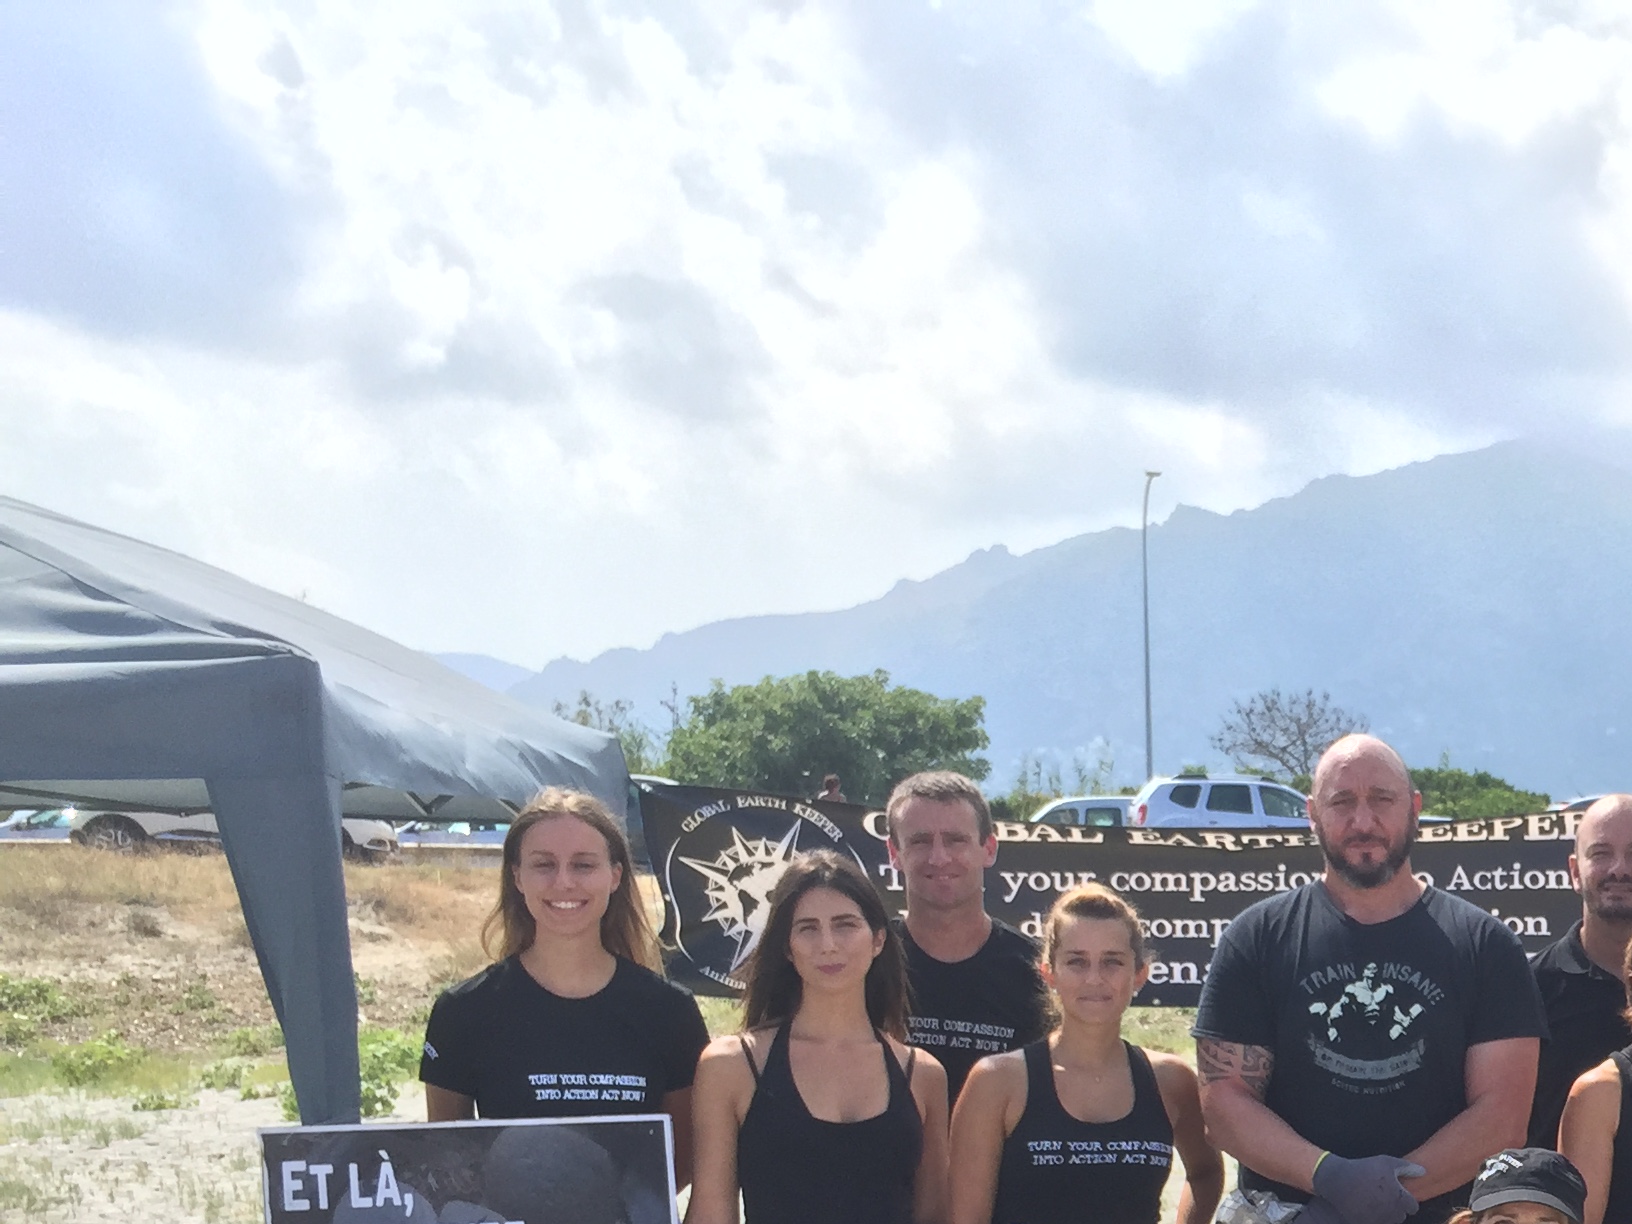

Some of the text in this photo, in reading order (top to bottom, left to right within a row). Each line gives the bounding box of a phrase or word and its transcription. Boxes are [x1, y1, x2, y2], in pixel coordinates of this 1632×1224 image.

[681, 795, 844, 843] GLOBAL EARTH KEEPER
[1000, 869, 1097, 903] your
[1446, 862, 1573, 891] Action
[699, 965, 747, 990] Anima
[1300, 962, 1445, 1006] TRAIN INSANE
[908, 1016, 1016, 1039] YOUR COMPASSION
[904, 1032, 947, 1046] ACTION
[949, 1037, 973, 1049] ACT
[528, 1074, 647, 1088] TURN YOUR COMPASSION
[535, 1089, 562, 1101] INTO
[563, 1089, 599, 1101] ACTION
[600, 1089, 621, 1101] ACT
[1027, 1141, 1103, 1152] TURN YOUR
[1032, 1155, 1065, 1166] INTO
[1068, 1153, 1118, 1165] ACTION
[1121, 1154, 1148, 1164] ACT
[282, 1149, 415, 1218] ET LÀ,
